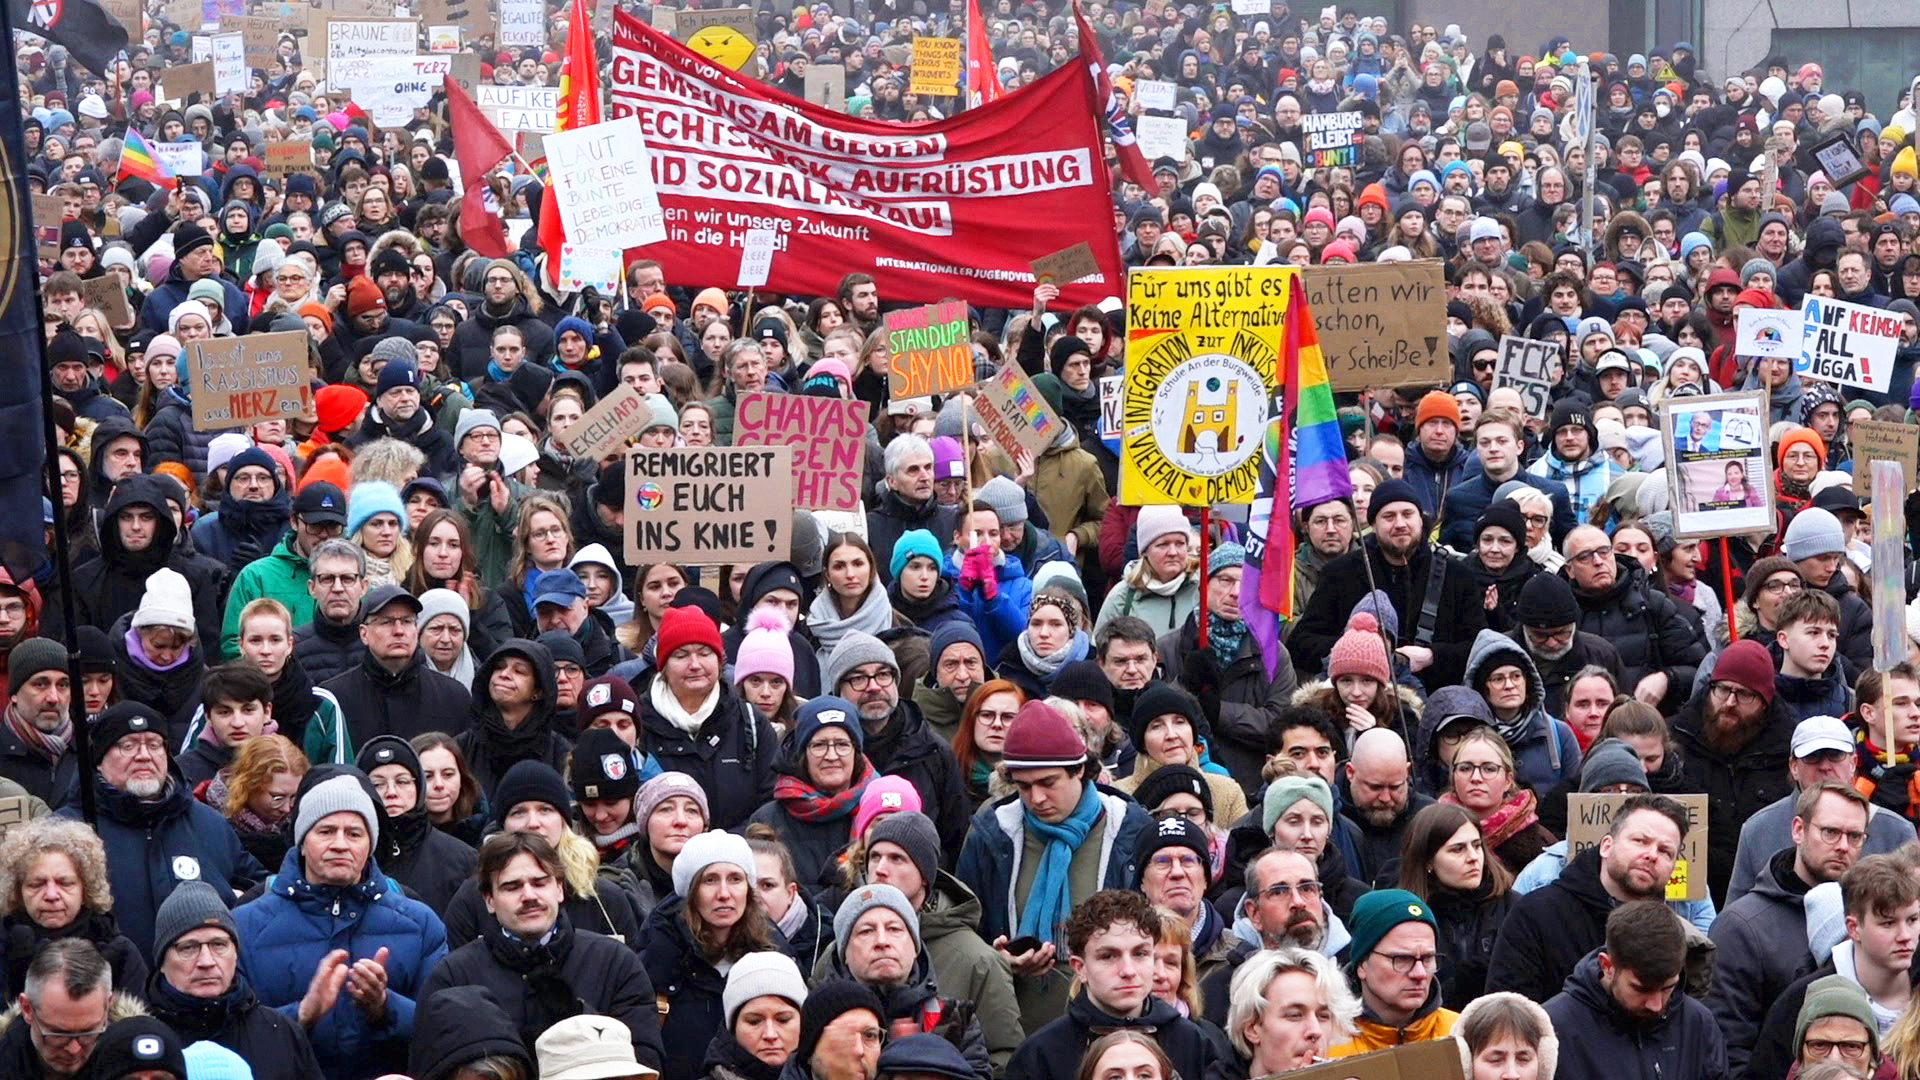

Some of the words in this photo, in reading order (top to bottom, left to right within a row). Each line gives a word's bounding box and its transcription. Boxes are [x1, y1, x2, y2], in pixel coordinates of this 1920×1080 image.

[330, 23, 391, 42] BRAUNE
[679, 15, 696, 28] Ich
[701, 14, 718, 25] bin
[915, 50, 941, 59] THINGS
[916, 40, 932, 48] YOU
[482, 88, 520, 105] AUF
[612, 55, 813, 147] GEMEINSAM
[502, 110, 554, 129] FALL
[1302, 110, 1364, 134] HAMBURG
[557, 134, 616, 169] LAUT
[1311, 129, 1355, 150] BLEIBT
[601, 160, 638, 182] EINE
[1315, 146, 1356, 168] BUNT!
[851, 154, 1081, 195] AUFRÜSTUNG
[567, 181, 626, 207] BUNTE
[671, 223, 688, 242] in
[694, 227, 724, 246] die
[694, 206, 722, 225] wir
[727, 212, 792, 233] unsere
[797, 216, 870, 242] Zukunft
[875, 256, 974, 277] INTERNATIONALER
[1129, 272, 1168, 299] Für
[1175, 279, 1211, 299] uns
[1215, 271, 1253, 306] gibt
[1260, 277, 1282, 296] es
[1130, 302, 1182, 329] Keine
[1315, 307, 1385, 336] schon,
[1805, 299, 1846, 327] AUF
[1348, 336, 1439, 371] Scheiße!
[1802, 324, 1854, 358] FALL
[255, 351, 283, 364] uns
[1500, 338, 1556, 382] FCK
[203, 365, 300, 394] RASSISMUS
[1125, 332, 1192, 424] INTEGRATION
[1195, 335, 1225, 348] zur
[1158, 367, 1187, 399] Schule
[1188, 360, 1202, 373] An
[1203, 358, 1221, 367] der
[1221, 357, 1262, 398] Burgweide
[570, 396, 639, 457] EKELHAFD
[738, 393, 866, 439] CHAYAS
[1001, 399, 1029, 433] STATT
[631, 451, 776, 478] REMIGRIERT
[1129, 432, 1194, 499] VIELFALT
[673, 482, 745, 512] EUCH
[636, 520, 681, 551] INS
[693, 521, 755, 552] KNIE
